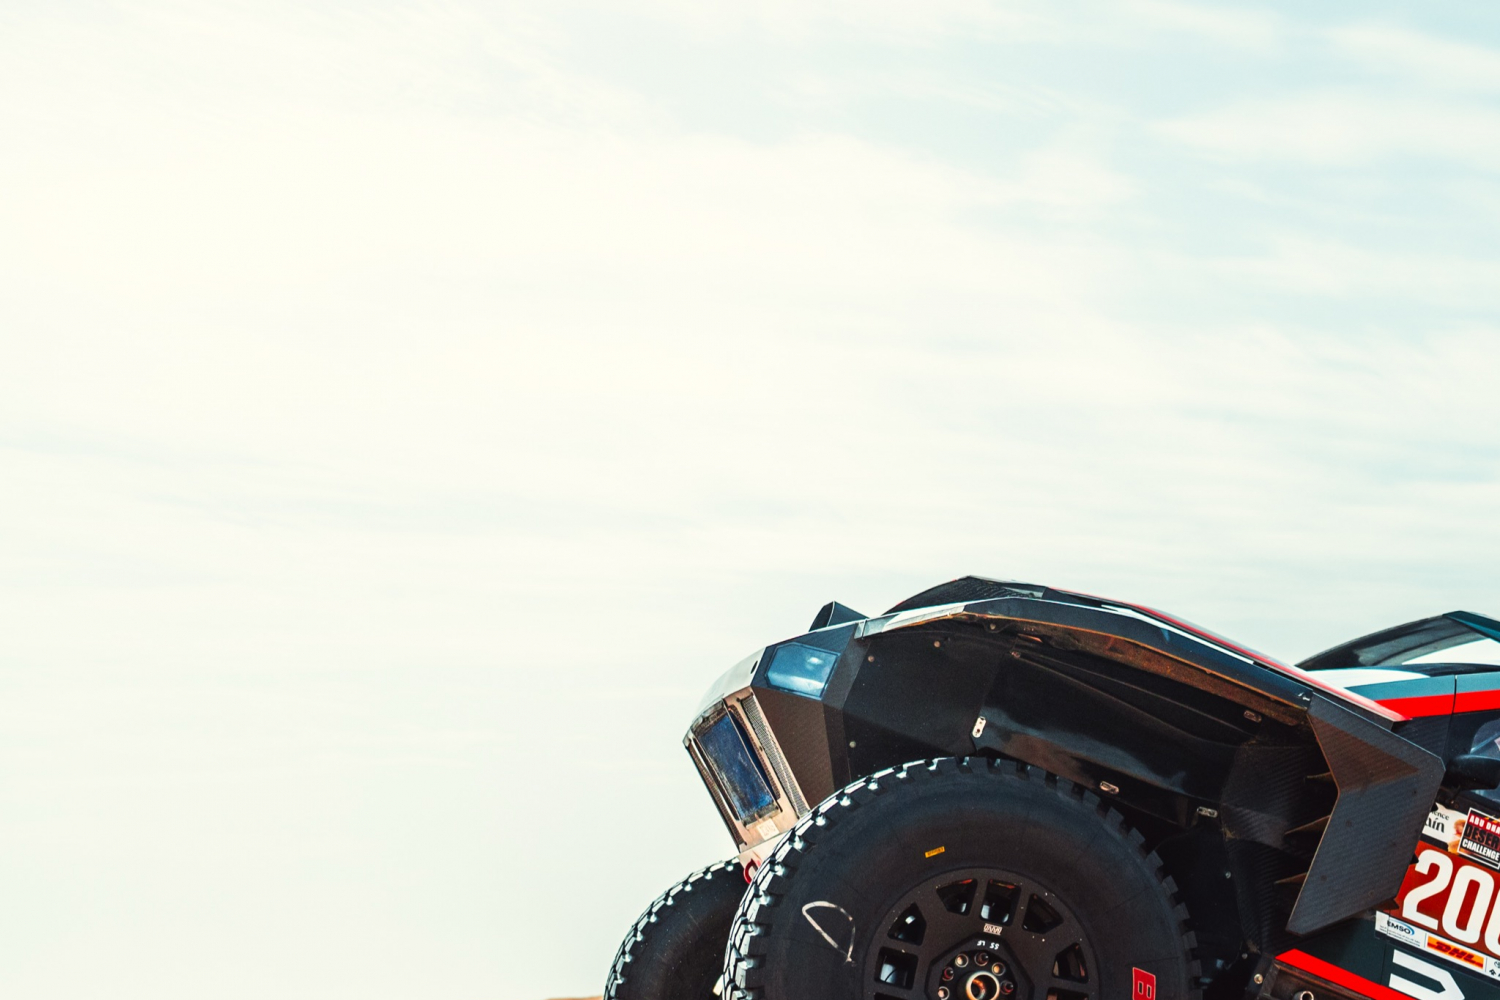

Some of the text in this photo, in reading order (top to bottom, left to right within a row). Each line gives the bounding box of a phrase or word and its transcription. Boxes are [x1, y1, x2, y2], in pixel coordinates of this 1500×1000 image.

[1468, 815, 1485, 827] ABU
[1461, 838, 1500, 861] CHALLENGE
[1387, 920, 1411, 935] EMSO
[1434, 940, 1478, 963] DHL
